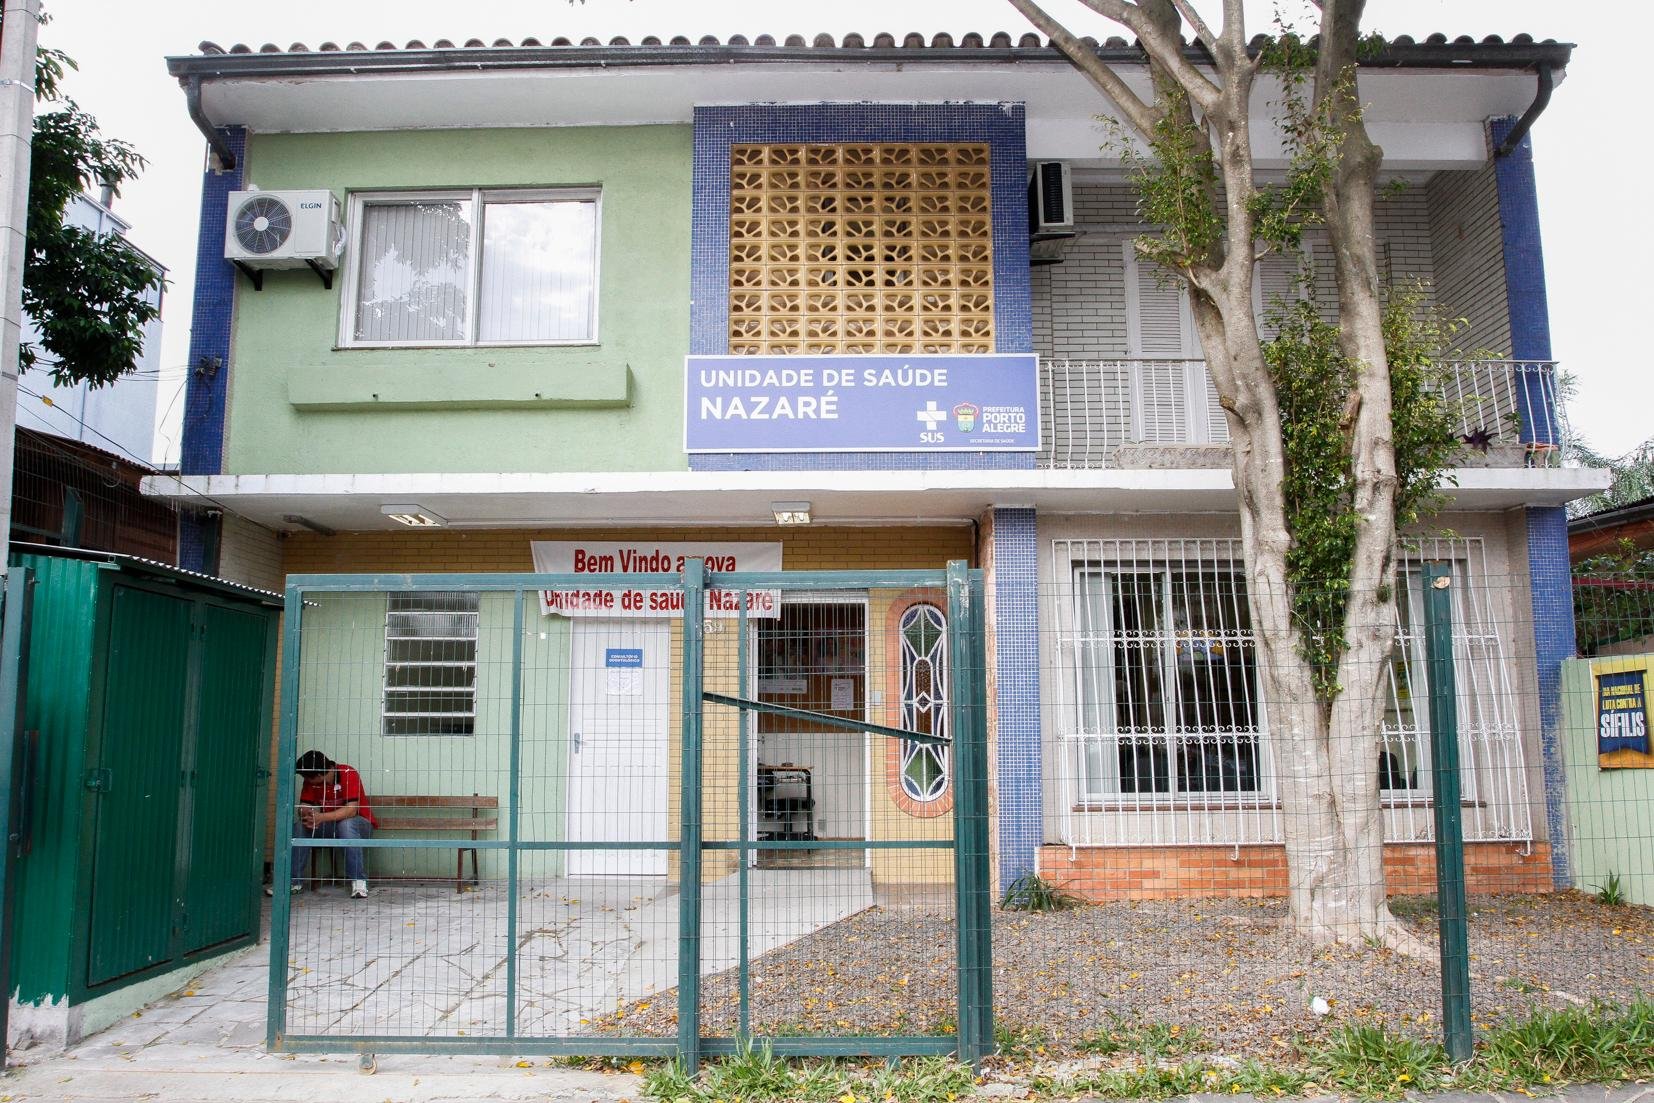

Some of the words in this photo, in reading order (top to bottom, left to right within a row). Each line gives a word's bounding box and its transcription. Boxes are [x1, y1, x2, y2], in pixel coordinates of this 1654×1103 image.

[700, 369, 814, 388] UNIDADE
[822, 369, 856, 387] DE
[863, 364, 948, 387] SAÚDE
[701, 389, 839, 420] NAZARÉ
[982, 413, 1026, 423] PORTO
[982, 423, 1026, 433] ALEGRE
[920, 432, 945, 443] SUS
[574, 549, 614, 573] Bem
[618, 549, 672, 573] Vindo
[704, 555, 736, 572] ova
[543, 589, 614, 610] Unidade
[621, 589, 644, 610] de
[1603, 700, 1616, 710] LUTA
[1617, 698, 1637, 709] CONTRA
[1600, 710, 1645, 738] SÍFILIS
